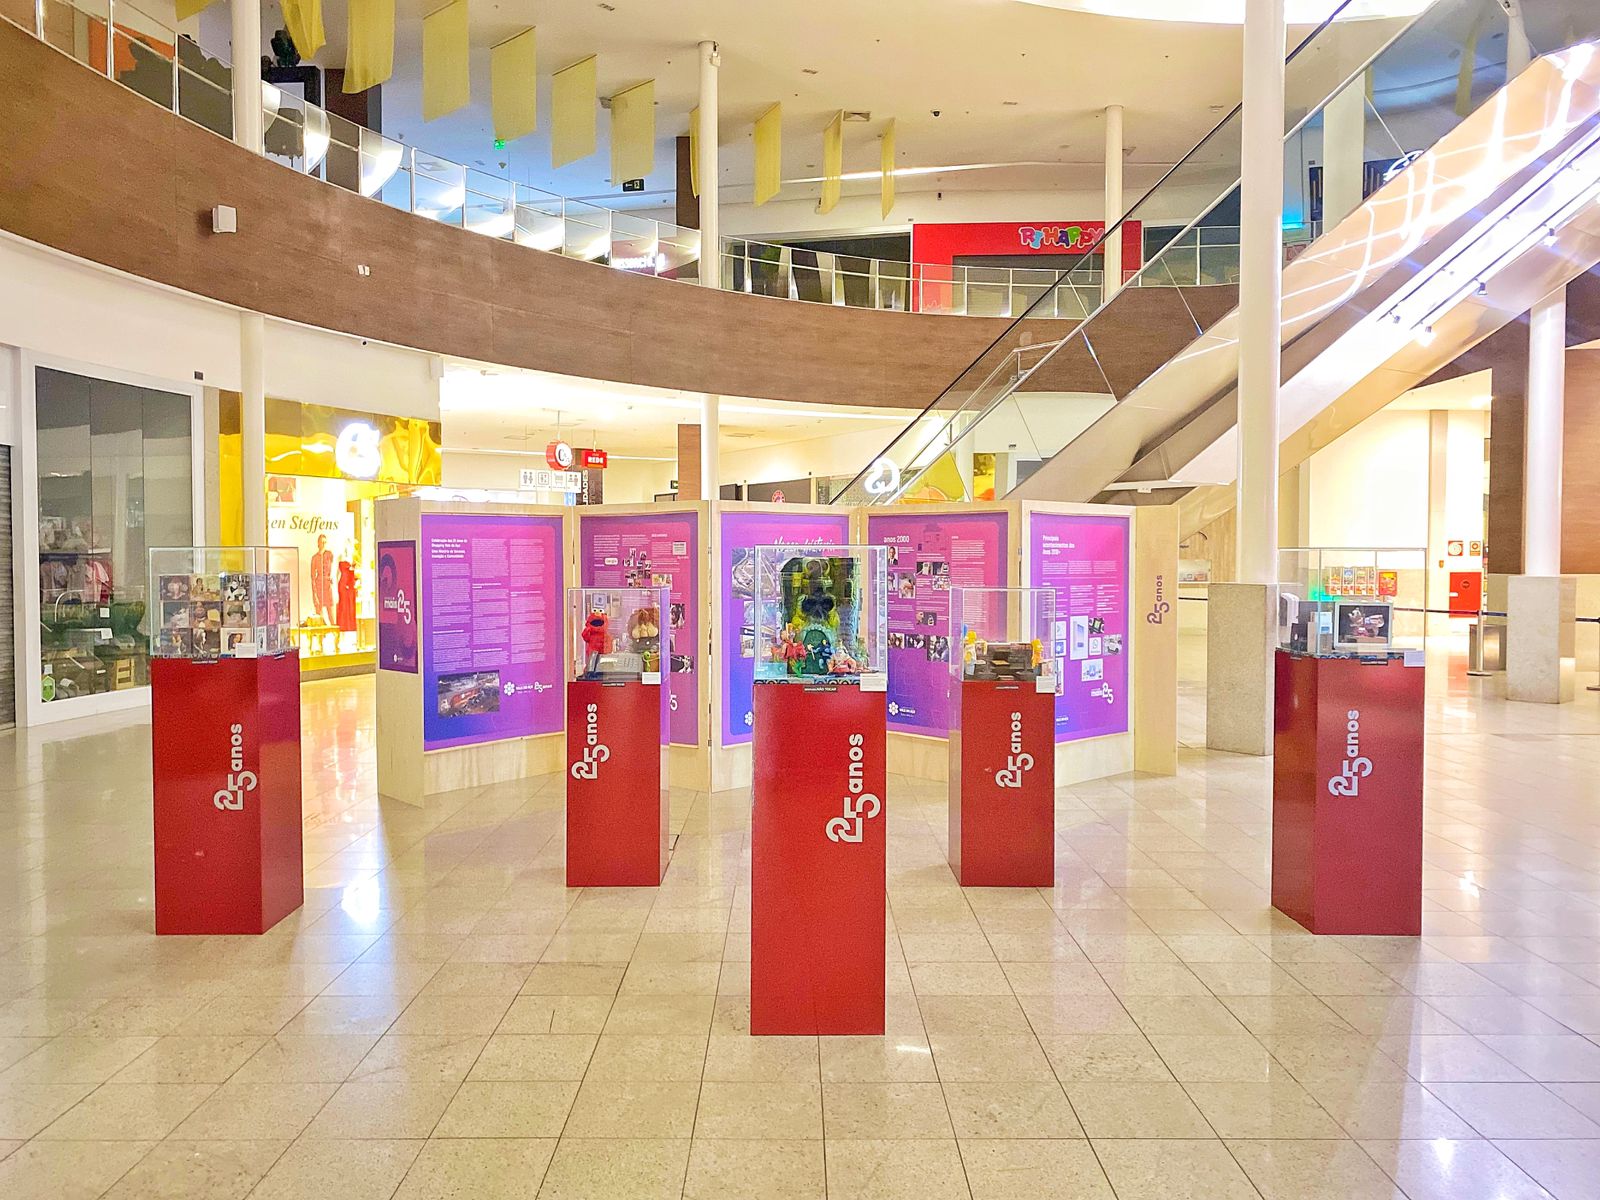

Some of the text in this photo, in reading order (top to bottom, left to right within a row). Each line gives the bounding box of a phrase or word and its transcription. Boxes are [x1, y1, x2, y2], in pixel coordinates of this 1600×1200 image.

[270, 515, 339, 534] en Steffens
[384, 589, 411, 625] mais 25
[1146, 602, 1170, 625] 25
[669, 694, 678, 711] 5
[1102, 682, 1114, 704] 25
[213, 723, 257, 810] 25 anos
[571, 703, 610, 779] 25 anos
[995, 712, 1034, 787] 25 anos
[1328, 710, 1373, 796] 25 anos
[825, 733, 881, 842] 25 anos
